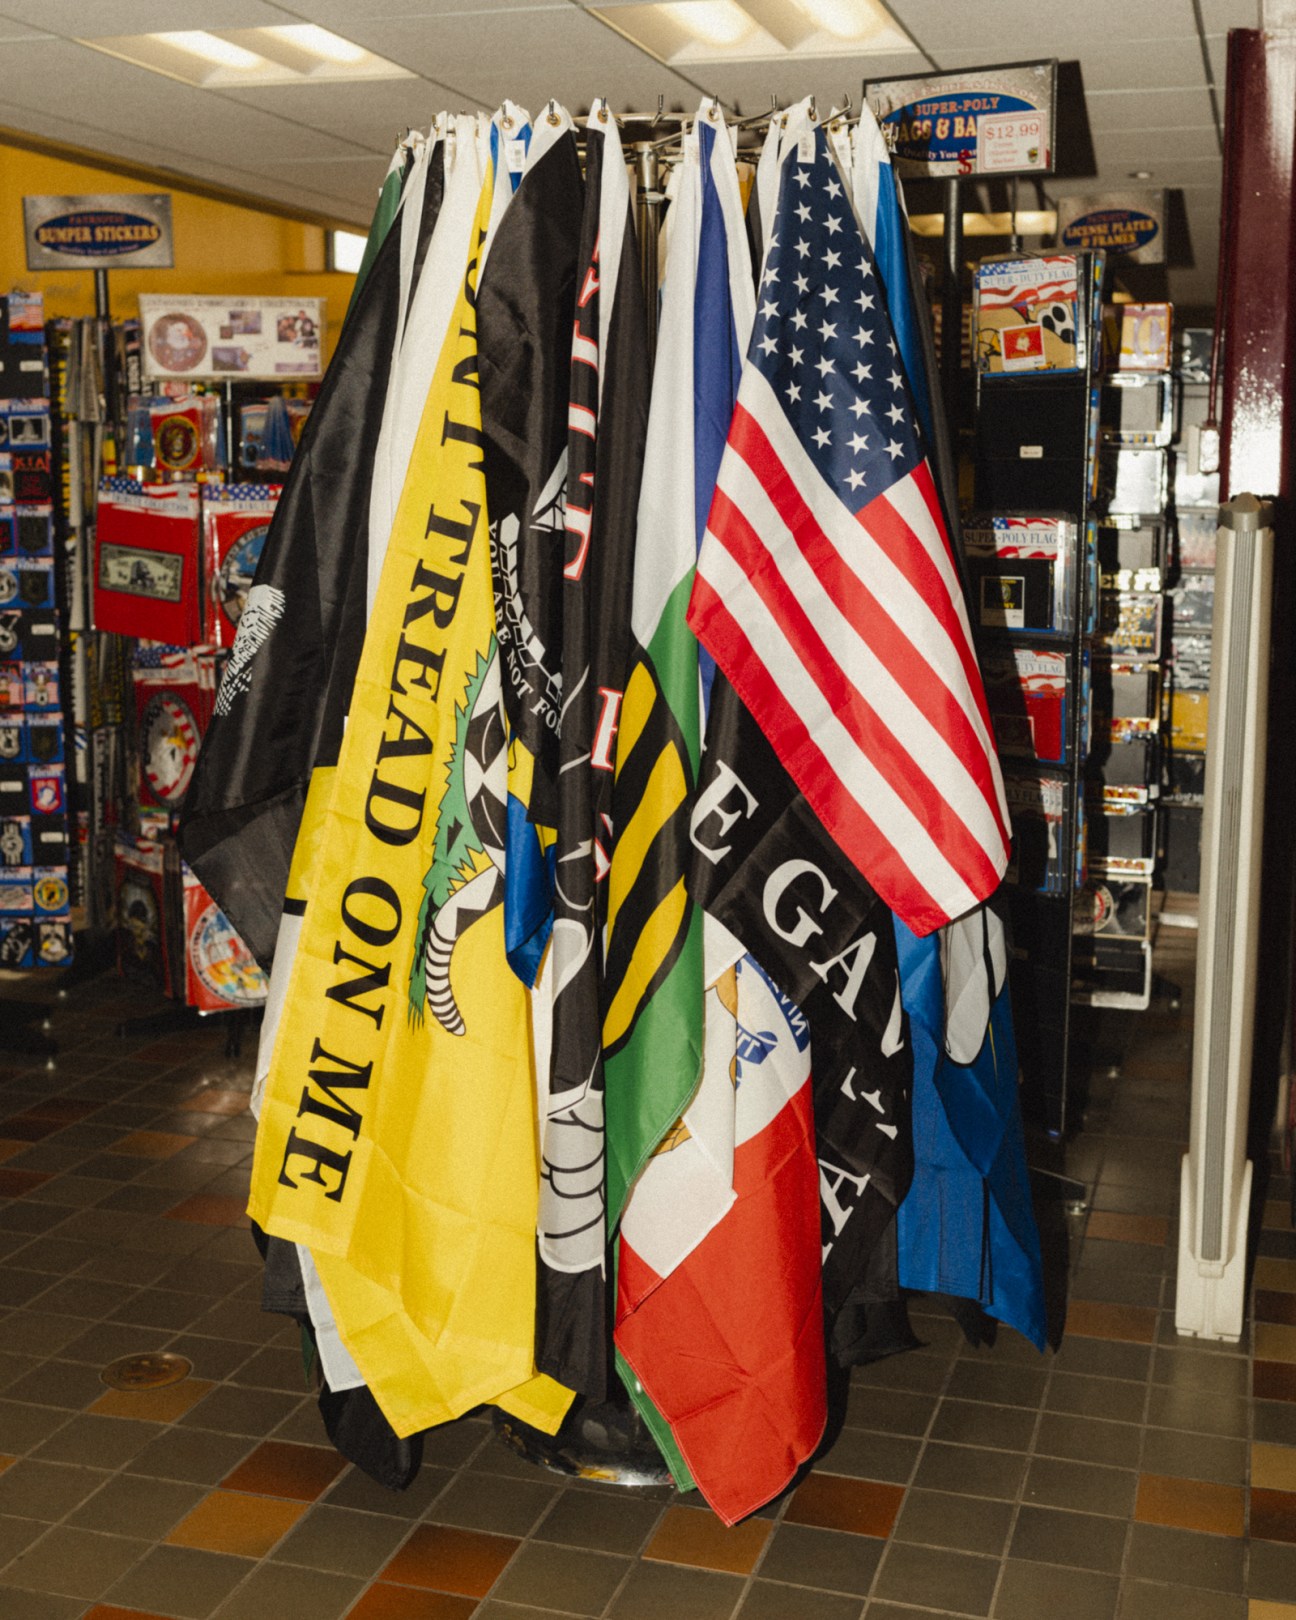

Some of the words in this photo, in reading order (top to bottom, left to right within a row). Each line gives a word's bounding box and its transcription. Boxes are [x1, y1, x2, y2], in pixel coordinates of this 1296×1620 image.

[915, 97, 1000, 115] SUPER-POLY
[936, 117, 950, 140] &
[985, 123, 1039, 140] $12.99
[39, 226, 92, 243] BUMPER
[94, 224, 160, 241] STICKERS
[965, 530, 1029, 544] SUPER-POLY
[1030, 532, 1057, 544] FLAG
[494, 590, 512, 646] ARE
[506, 648, 534, 700] NOT
[365, 499, 481, 846] TREAD
[325, 876, 402, 1030] ON
[278, 1037, 374, 1203] ME
